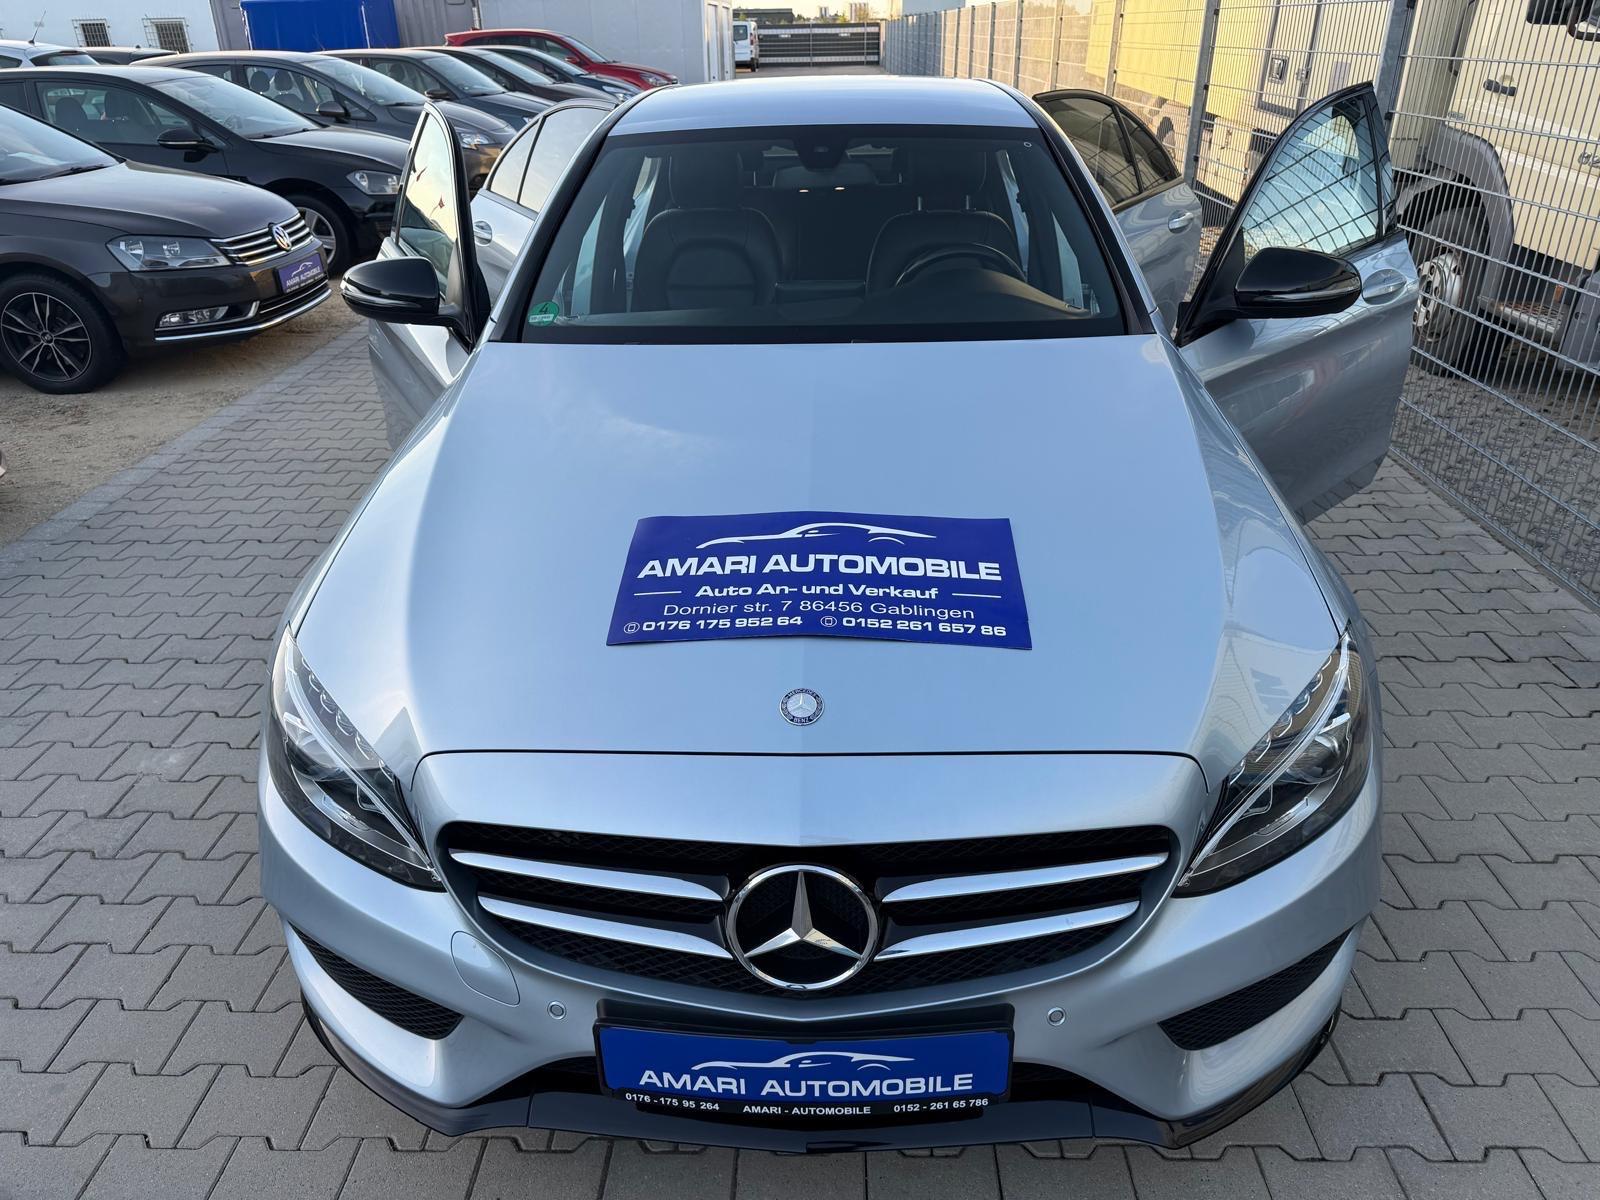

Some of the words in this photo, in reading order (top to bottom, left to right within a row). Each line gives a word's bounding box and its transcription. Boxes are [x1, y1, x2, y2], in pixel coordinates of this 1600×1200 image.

[539, 303, 549, 315] 4
[637, 555, 757, 578] AMARI
[762, 554, 1002, 581] AUTOMOBILE
[695, 585, 752, 597] Auto
[756, 583, 798, 595] An-
[802, 583, 843, 595] und
[848, 584, 939, 599] Verkauf
[663, 604, 738, 616] Dornier
[743, 601, 773, 613] str.
[781, 600, 792, 612] 7
[800, 600, 863, 613] 86456
[870, 602, 975, 620] Gablingen
[642, 620, 691, 631] 0176
[696, 618, 731, 630] 175
[735, 617, 773, 628] 952
[777, 616, 803, 627] 64
[842, 617, 892, 629] 0152
[896, 620, 933, 632] 261
[938, 622, 976, 634] 657
[981, 625, 1007, 636] 86
[639, 1070, 746, 1095] AMARI
[760, 1073, 974, 1097] AUTOMOBILE
[625, 1092, 651, 1103] 0176
[660, 1097, 679, 1107] 175
[682, 1099, 696, 1109] 95
[700, 1101, 720, 1111] 264
[742, 1105, 782, 1115] AMARI
[791, 1106, 872, 1116] AUTOMOBILE
[893, 1104, 920, 1113] 0152
[930, 1101, 949, 1111] 261
[952, 1100, 966, 1110] 65
[969, 1098, 989, 1108] 786
